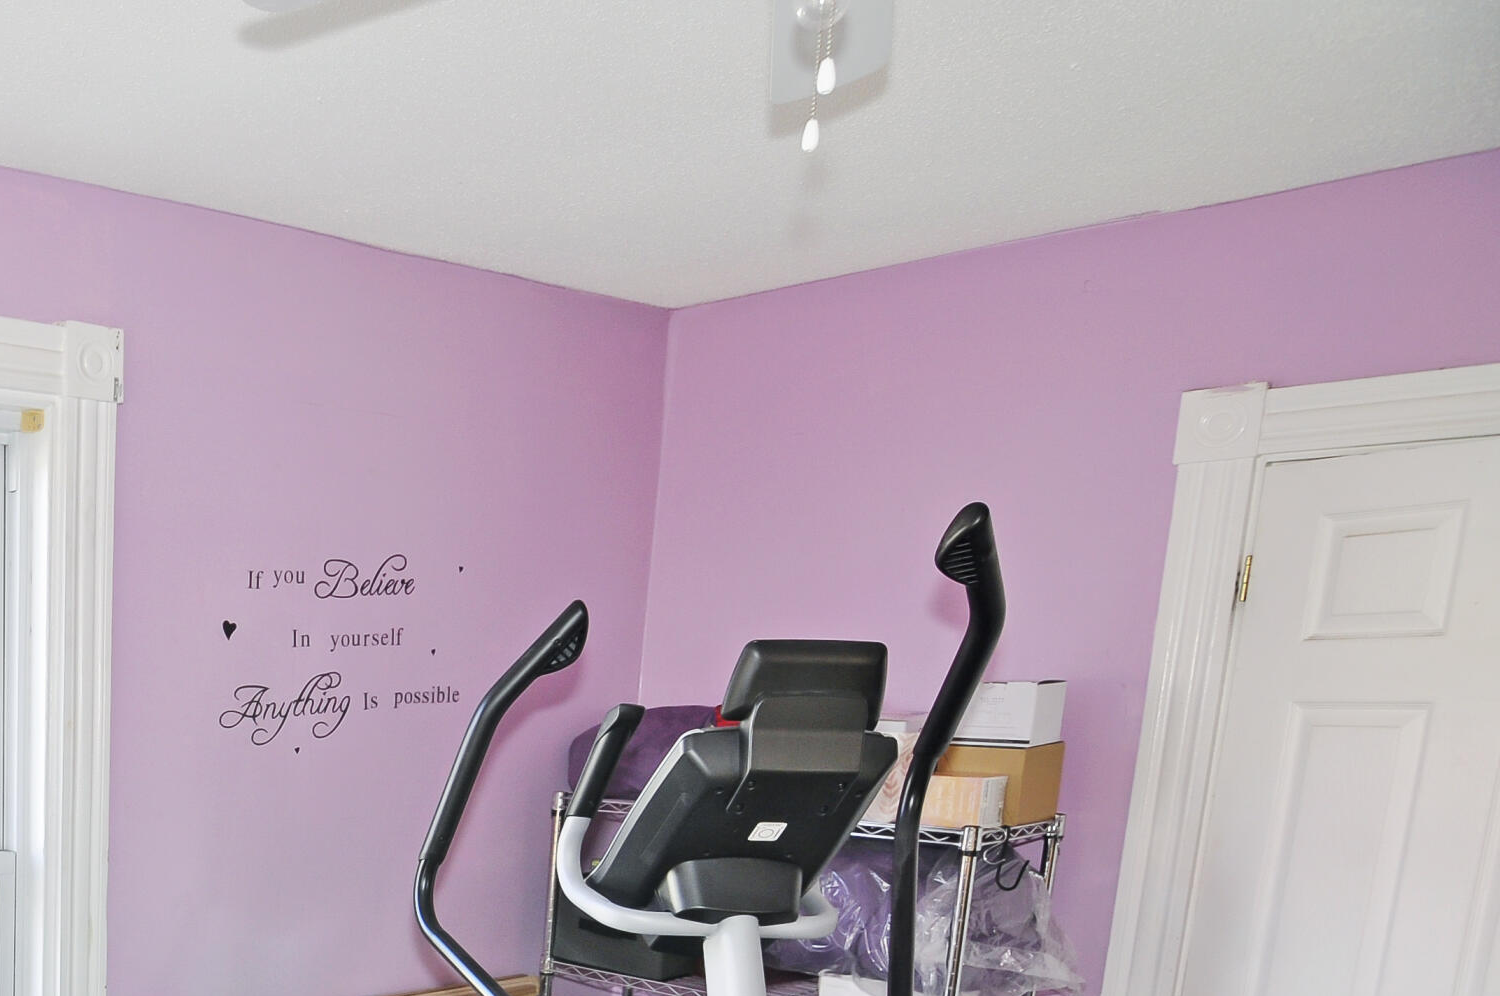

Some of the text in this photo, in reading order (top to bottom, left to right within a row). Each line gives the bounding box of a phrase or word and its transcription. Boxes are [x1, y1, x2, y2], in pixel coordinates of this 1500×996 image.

[247, 553, 415, 599] If you Believe
[291, 628, 404, 652] In yourself
[219, 671, 460, 746] Anything Is possible
